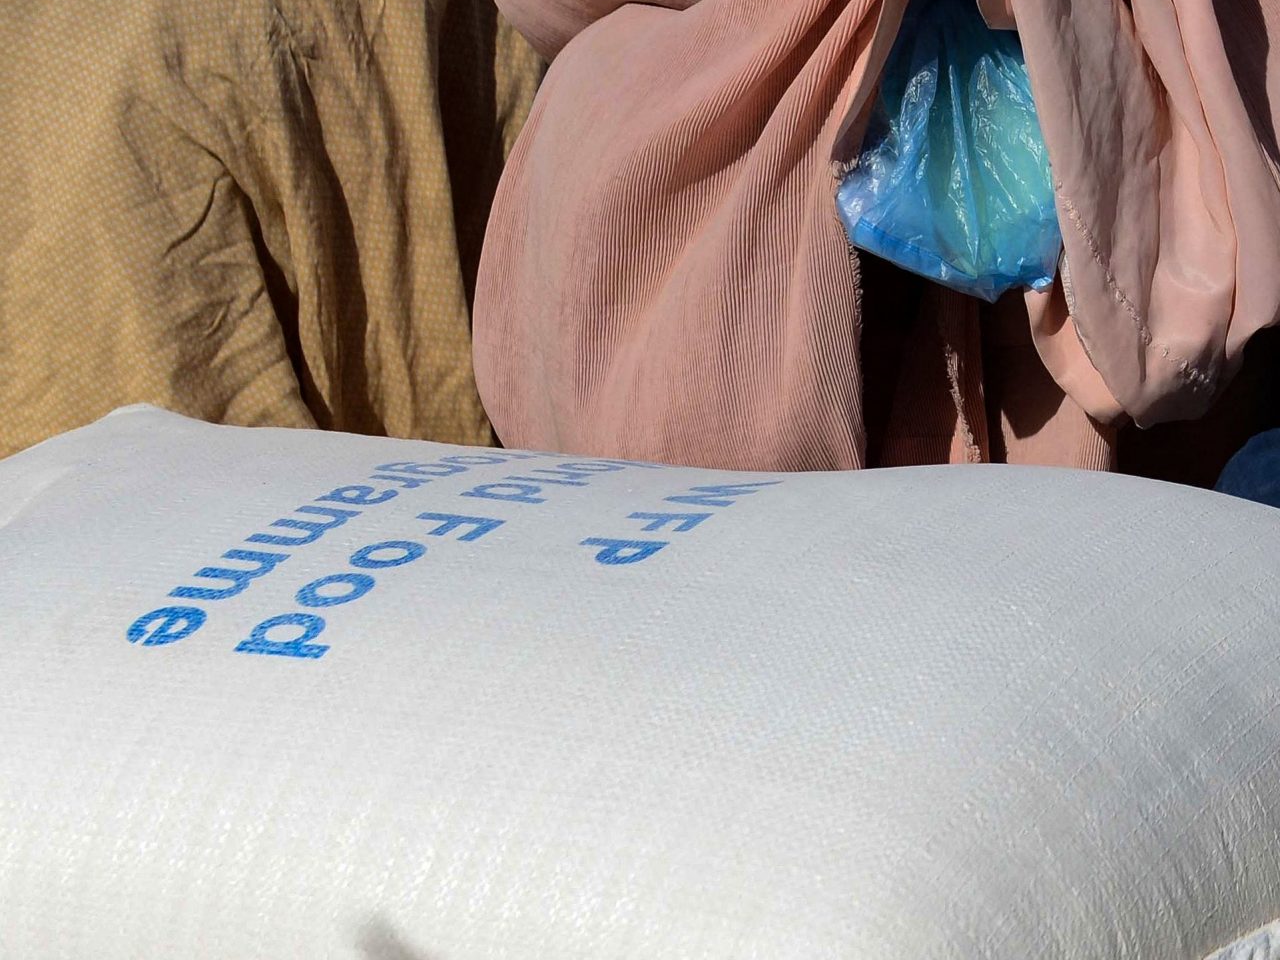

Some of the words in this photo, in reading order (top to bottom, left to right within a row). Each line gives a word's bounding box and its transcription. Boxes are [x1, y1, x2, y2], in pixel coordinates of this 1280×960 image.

[125, 452, 562, 647] rogramme
[232, 511, 504, 660] Food
[579, 479, 785, 565] WFP
